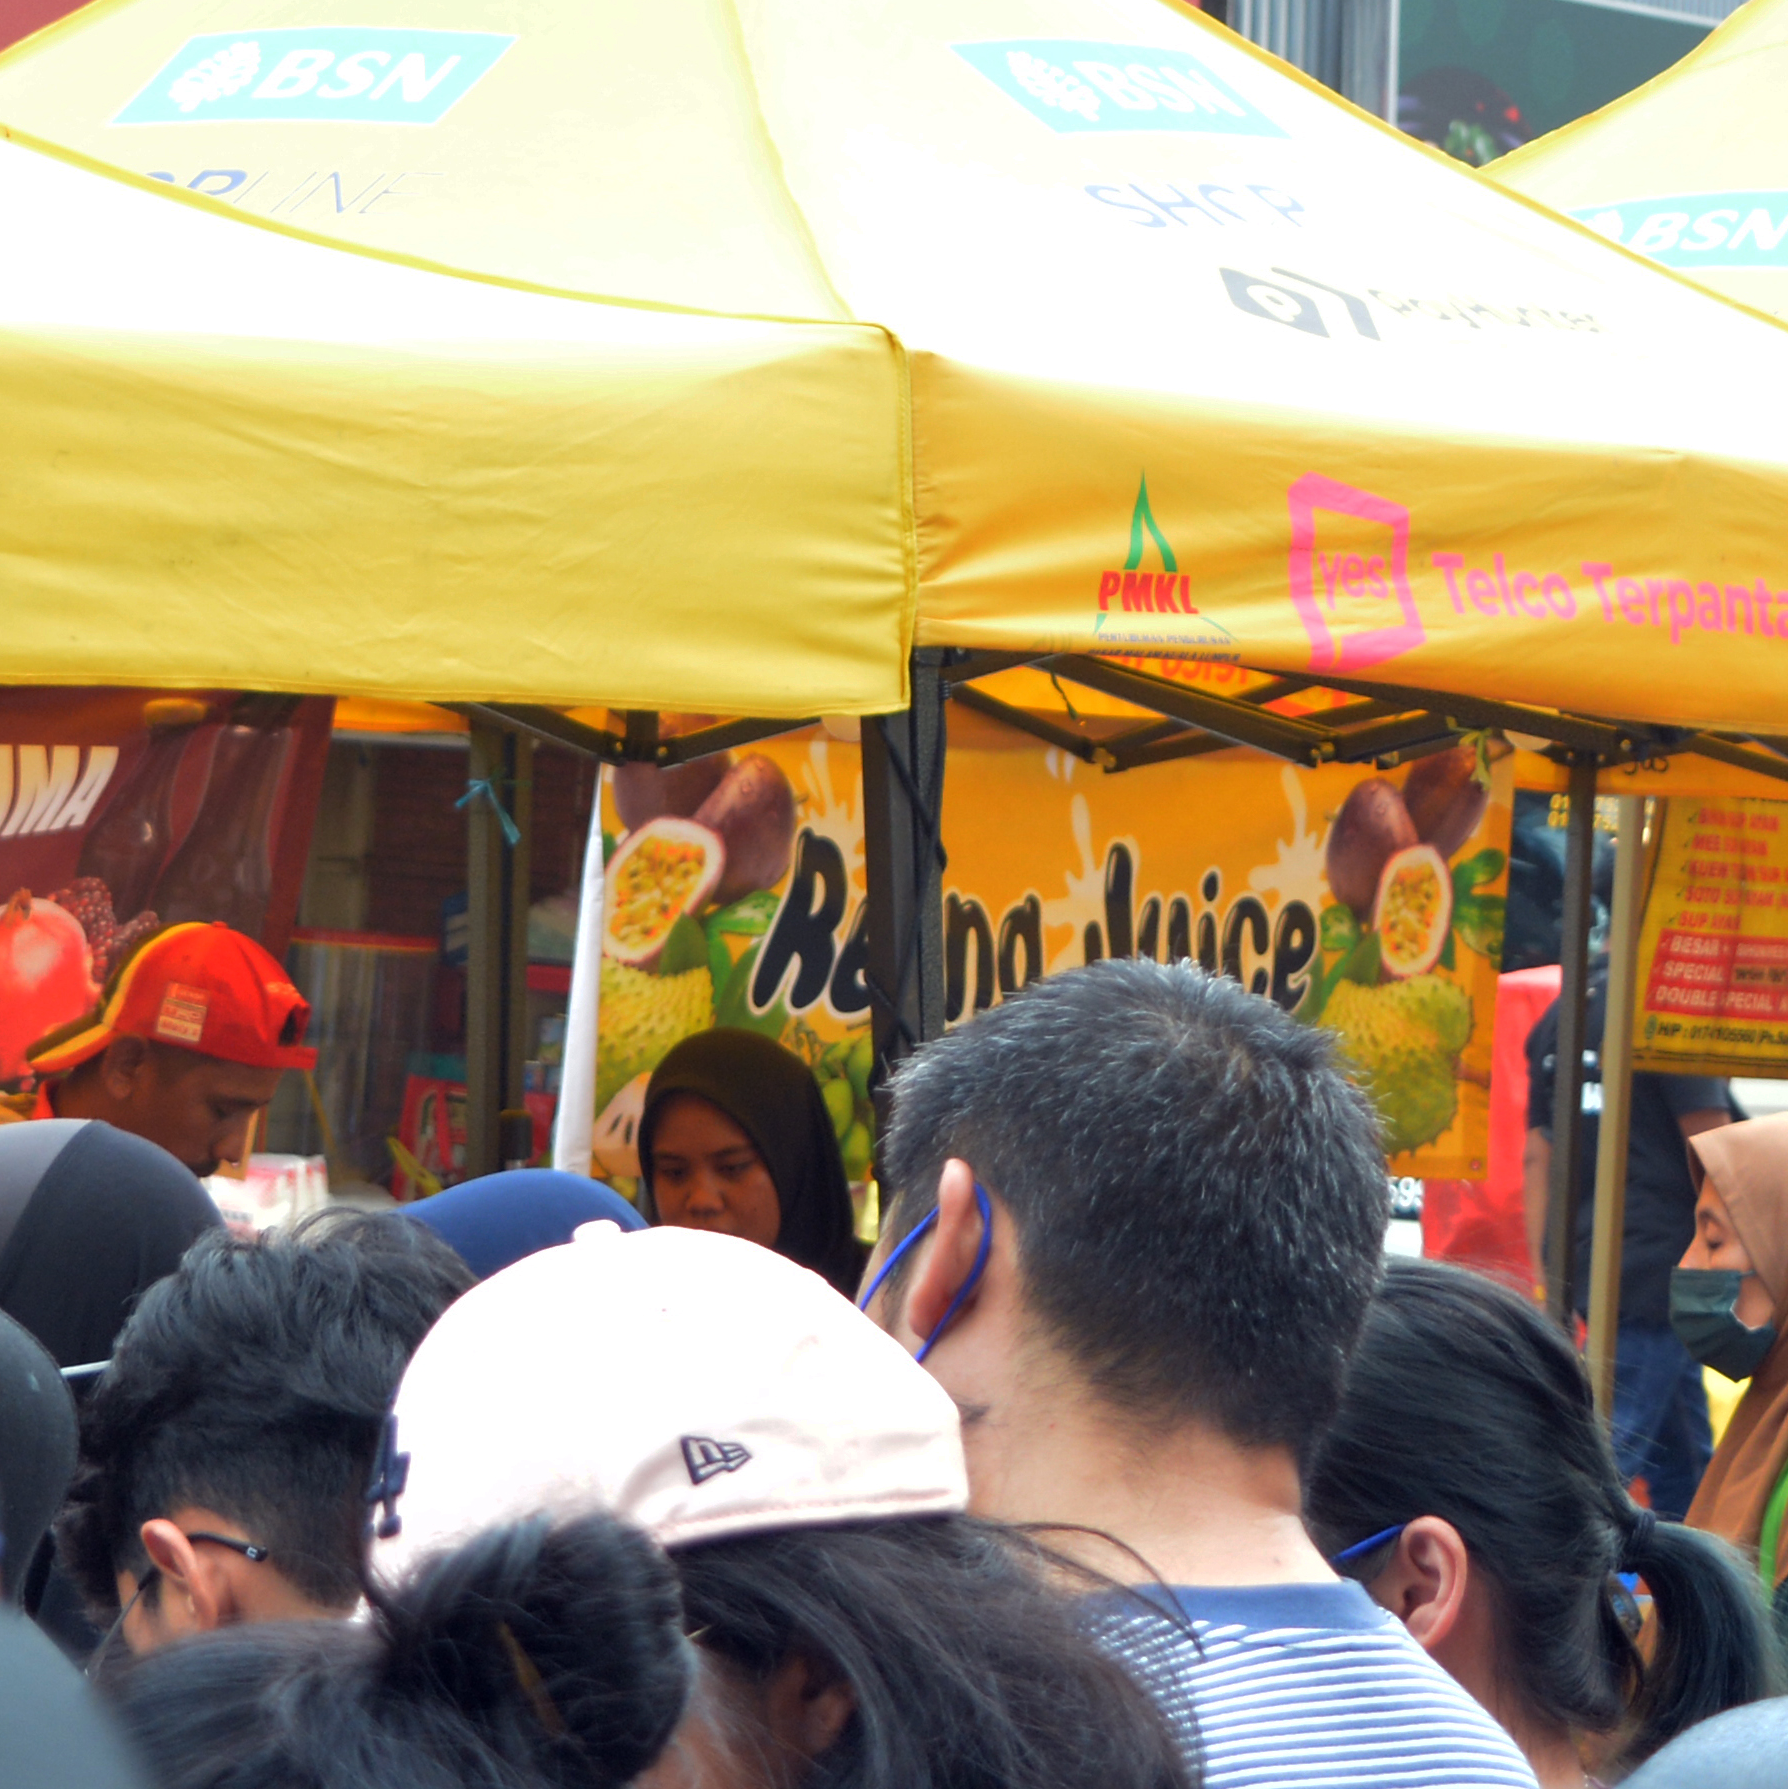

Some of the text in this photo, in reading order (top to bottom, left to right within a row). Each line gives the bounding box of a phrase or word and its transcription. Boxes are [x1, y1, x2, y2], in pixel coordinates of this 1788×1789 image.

[251, 49, 462, 103] BSN
[1090, 62, 1249, 119] BSN
[1098, 570, 1200, 615] PMKL
[1316, 547, 1389, 610] yes
[1431, 552, 1577, 622] Telco
[1083, 841, 1317, 1013] Juice
[1655, 985, 1716, 1007] DOUBLE
[1663, 960, 1724, 982] SPECIAL
